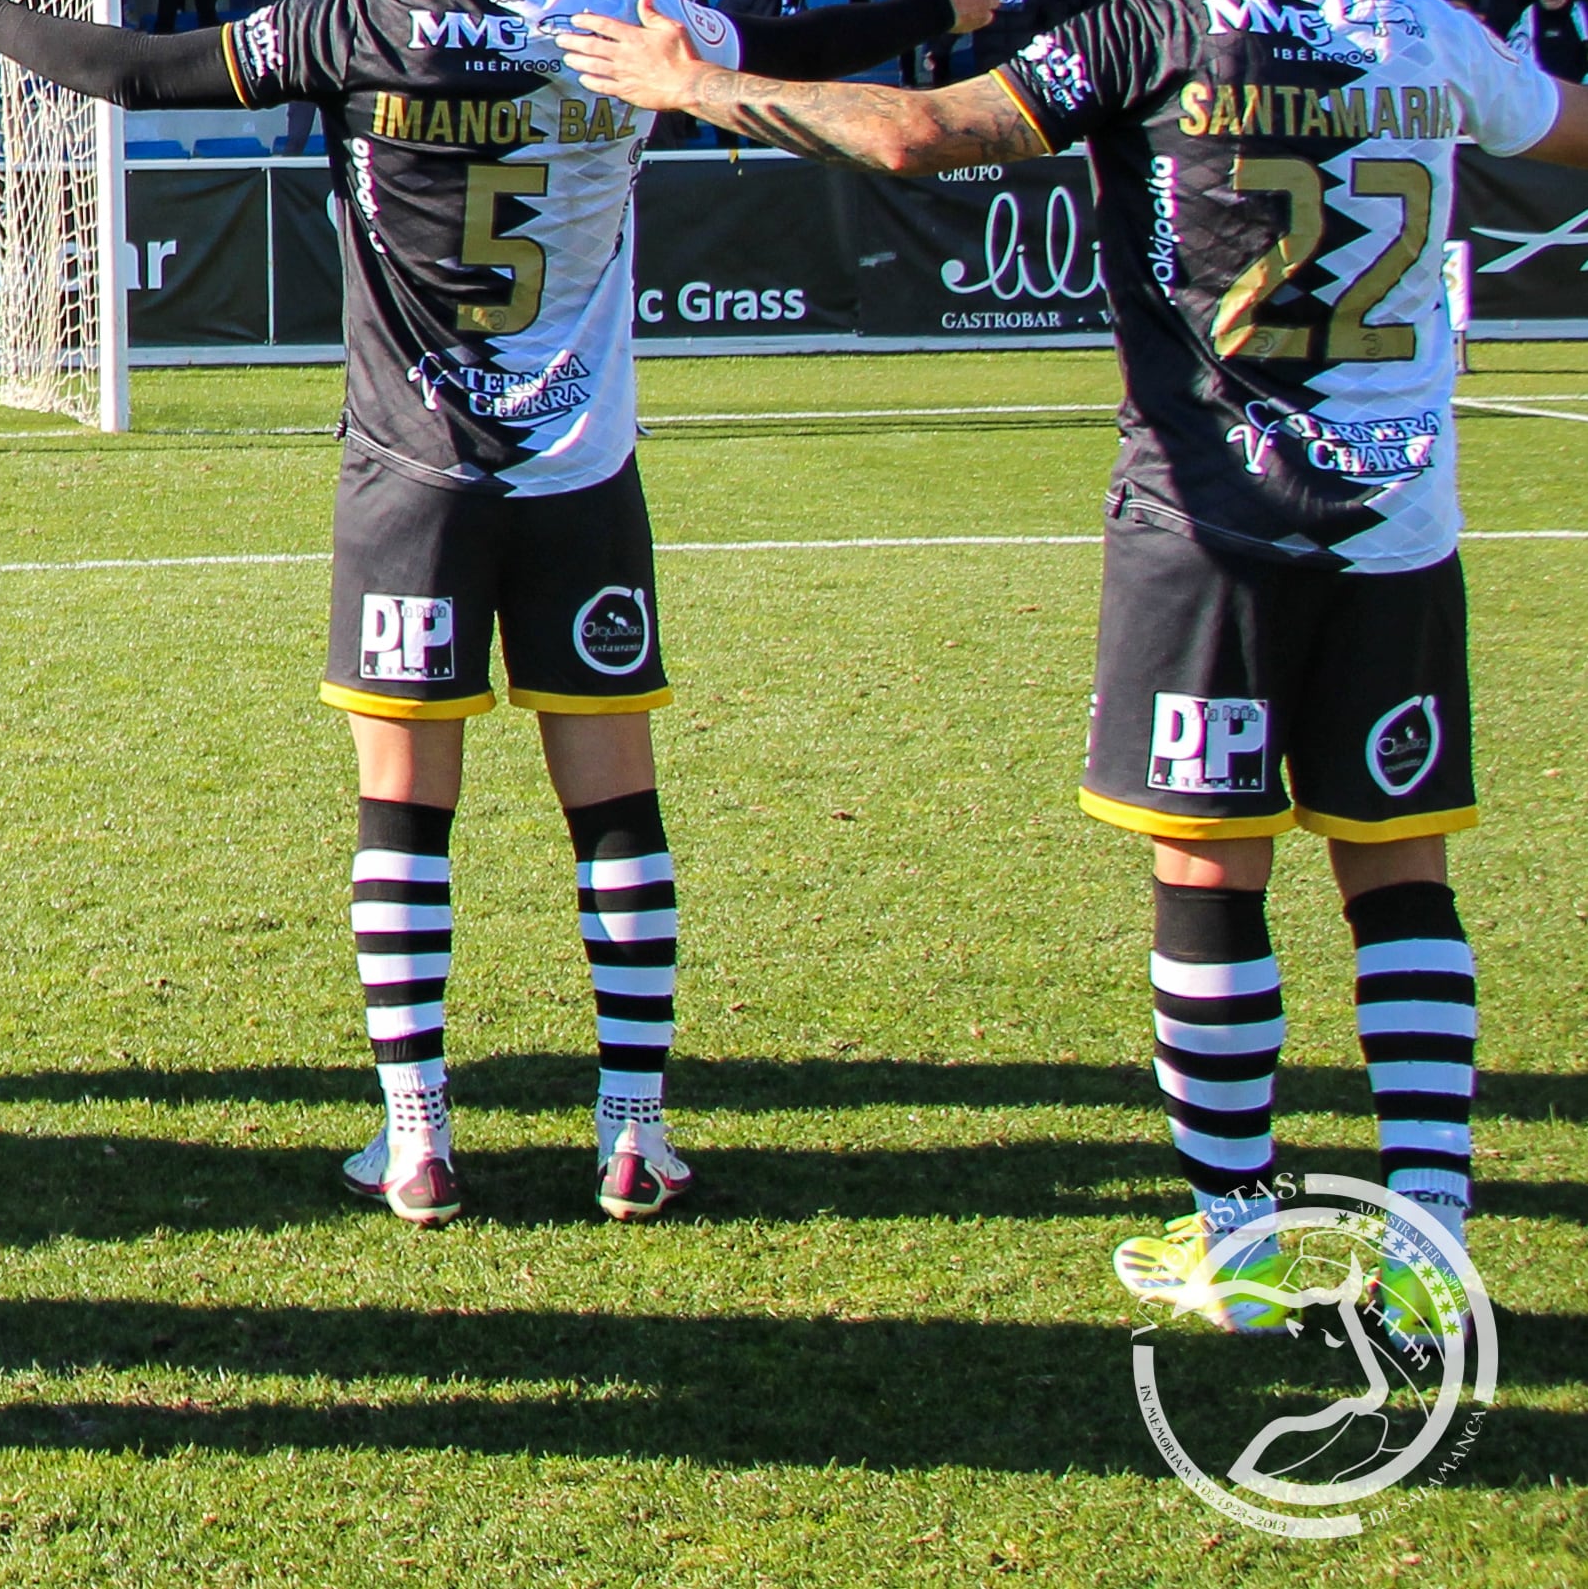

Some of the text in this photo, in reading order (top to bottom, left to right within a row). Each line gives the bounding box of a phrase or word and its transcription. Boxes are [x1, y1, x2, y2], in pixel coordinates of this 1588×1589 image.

[373, 91, 550, 143] IMANOL
[938, 165, 1003, 183] GRUPO
[456, 164, 548, 336] 5
[1212, 154, 1432, 362] 22
[678, 282, 806, 322] Grass
[941, 312, 1062, 329] GASTROBAR
[1307, 434, 1435, 474] CHARR
